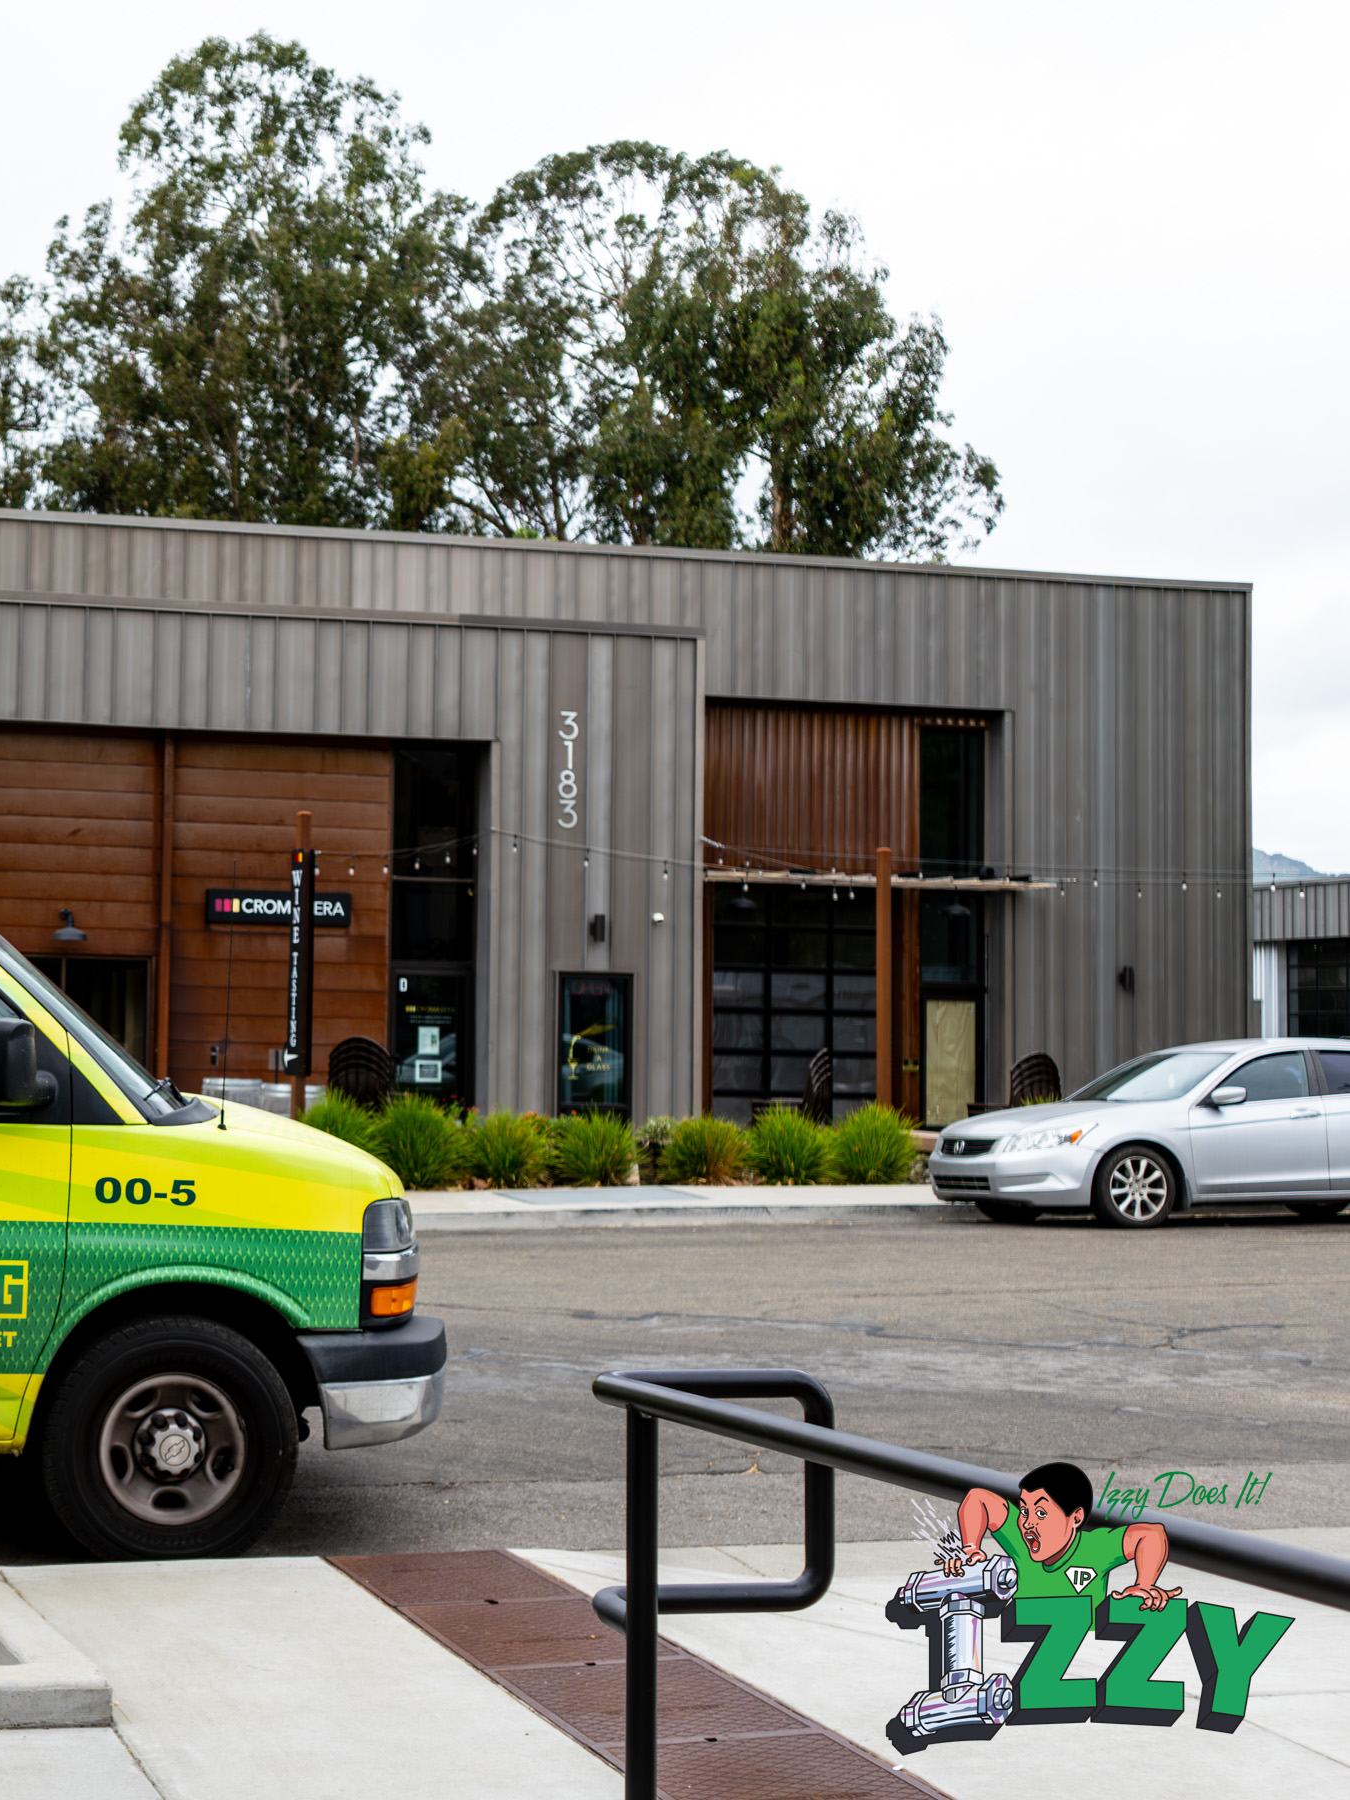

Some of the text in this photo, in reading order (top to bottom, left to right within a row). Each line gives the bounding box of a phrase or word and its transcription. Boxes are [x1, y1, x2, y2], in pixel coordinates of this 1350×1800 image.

[557, 711, 579, 828] 3183
[241, 898, 345, 917] CROMERA
[289, 869, 303, 1047] WINE TASTING
[586, 1063, 610, 1071] GLASS
[94, 1177, 197, 1207] 00-5
